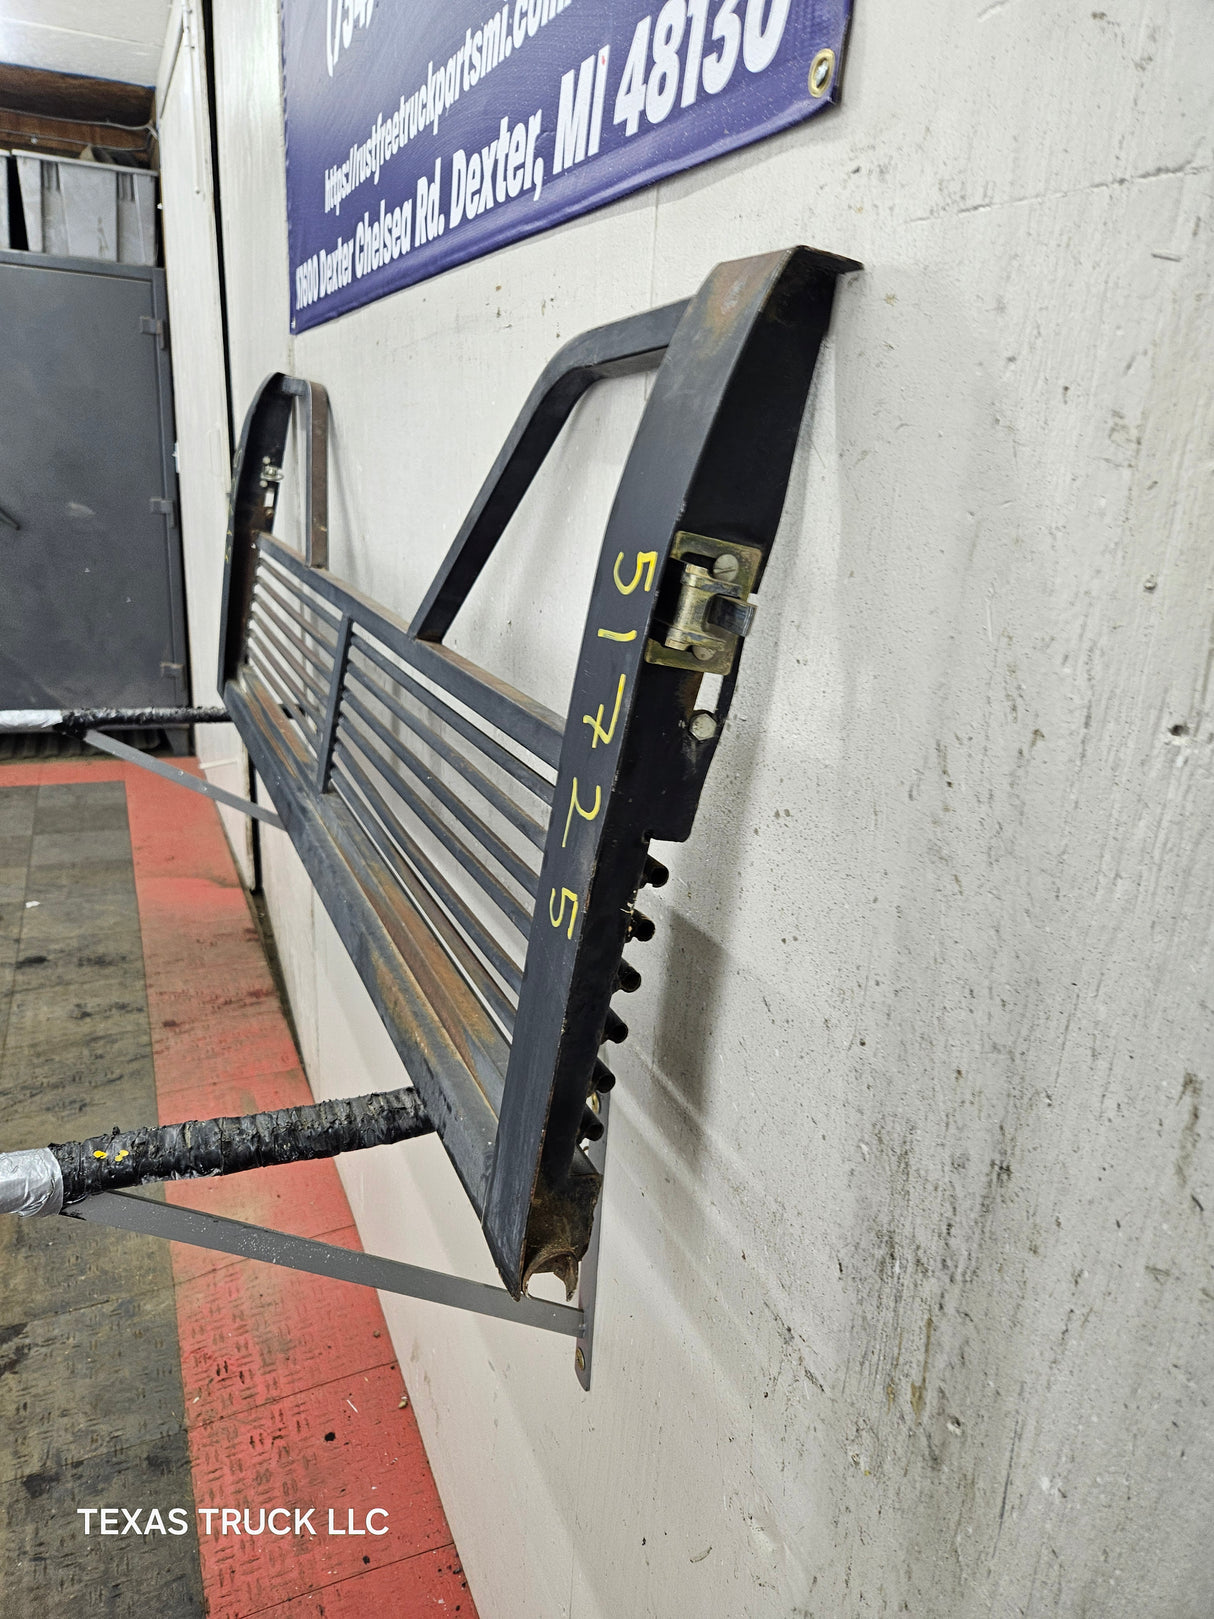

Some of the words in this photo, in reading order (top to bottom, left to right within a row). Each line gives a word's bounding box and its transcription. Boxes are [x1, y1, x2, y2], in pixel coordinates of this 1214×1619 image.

[319, 237, 354, 299] Dexter
[355, 199, 412, 279] Chelsea
[415, 157, 445, 247] Rd.
[449, 109, 544, 229] Dexter,
[553, 44, 610, 175] MI
